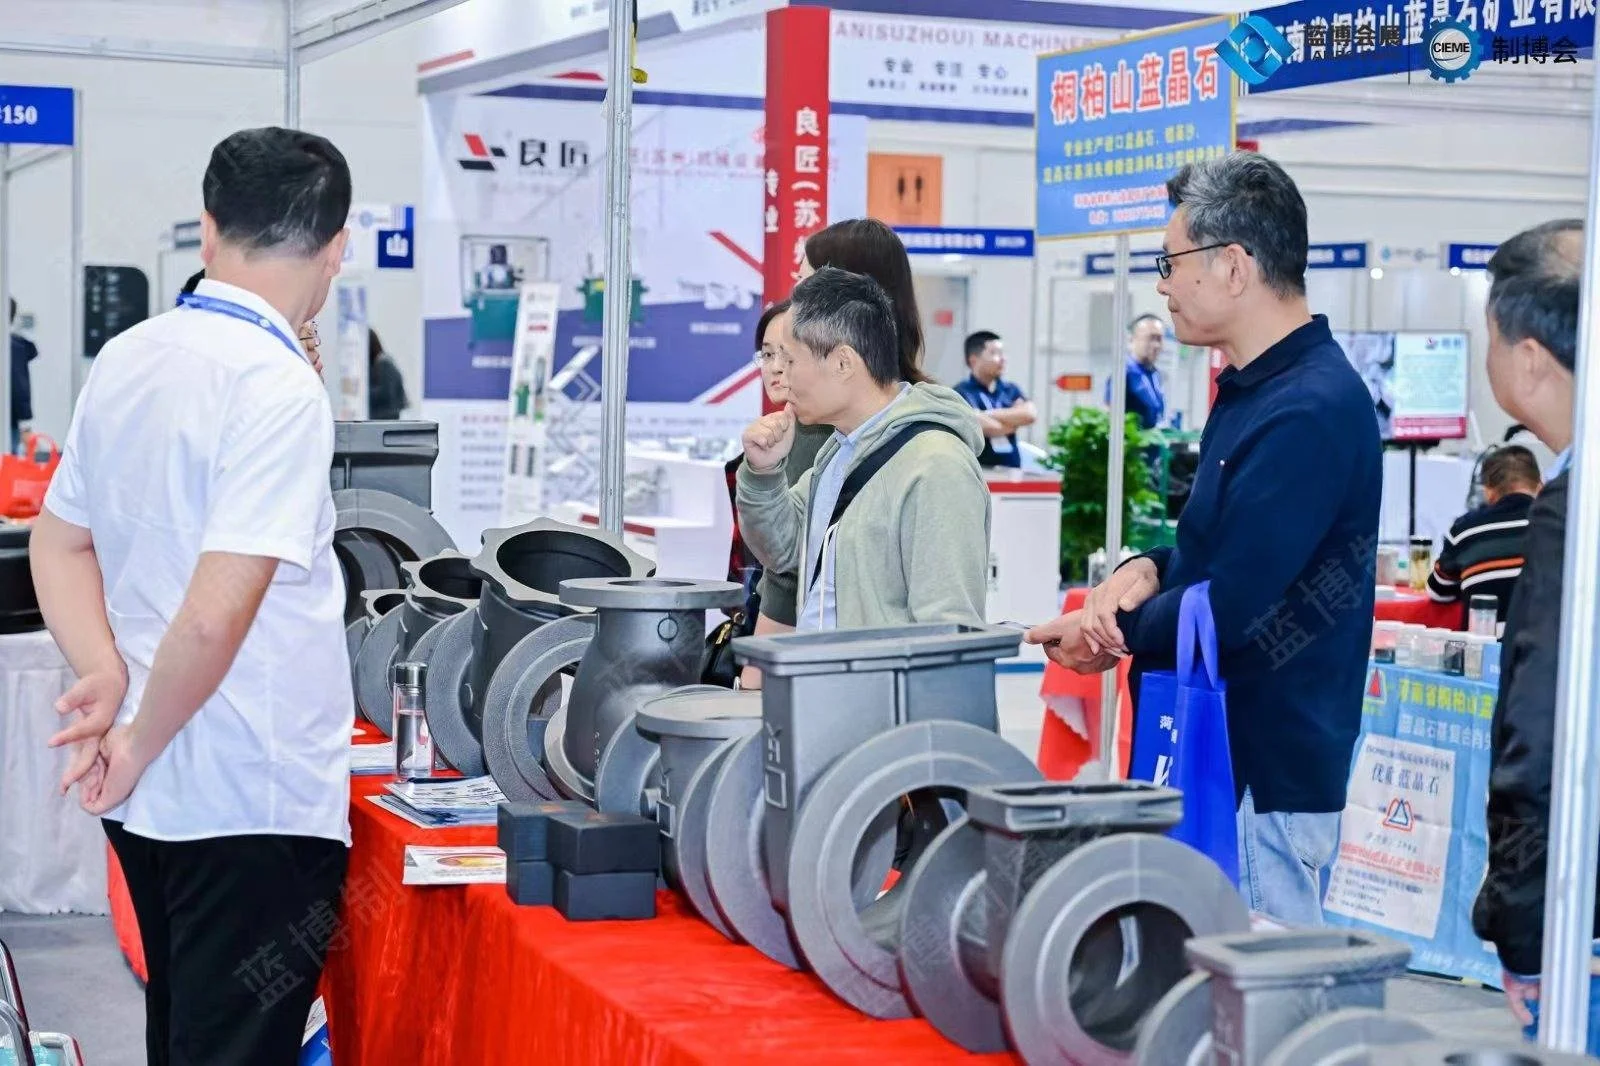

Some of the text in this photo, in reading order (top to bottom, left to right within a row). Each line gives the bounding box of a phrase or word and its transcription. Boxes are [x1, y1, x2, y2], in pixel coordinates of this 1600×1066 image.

[1052, 42, 1219, 125] 桐柏山蓝晶石
[0, 104, 38, 125] 150
[519, 138, 588, 168] 良匠
